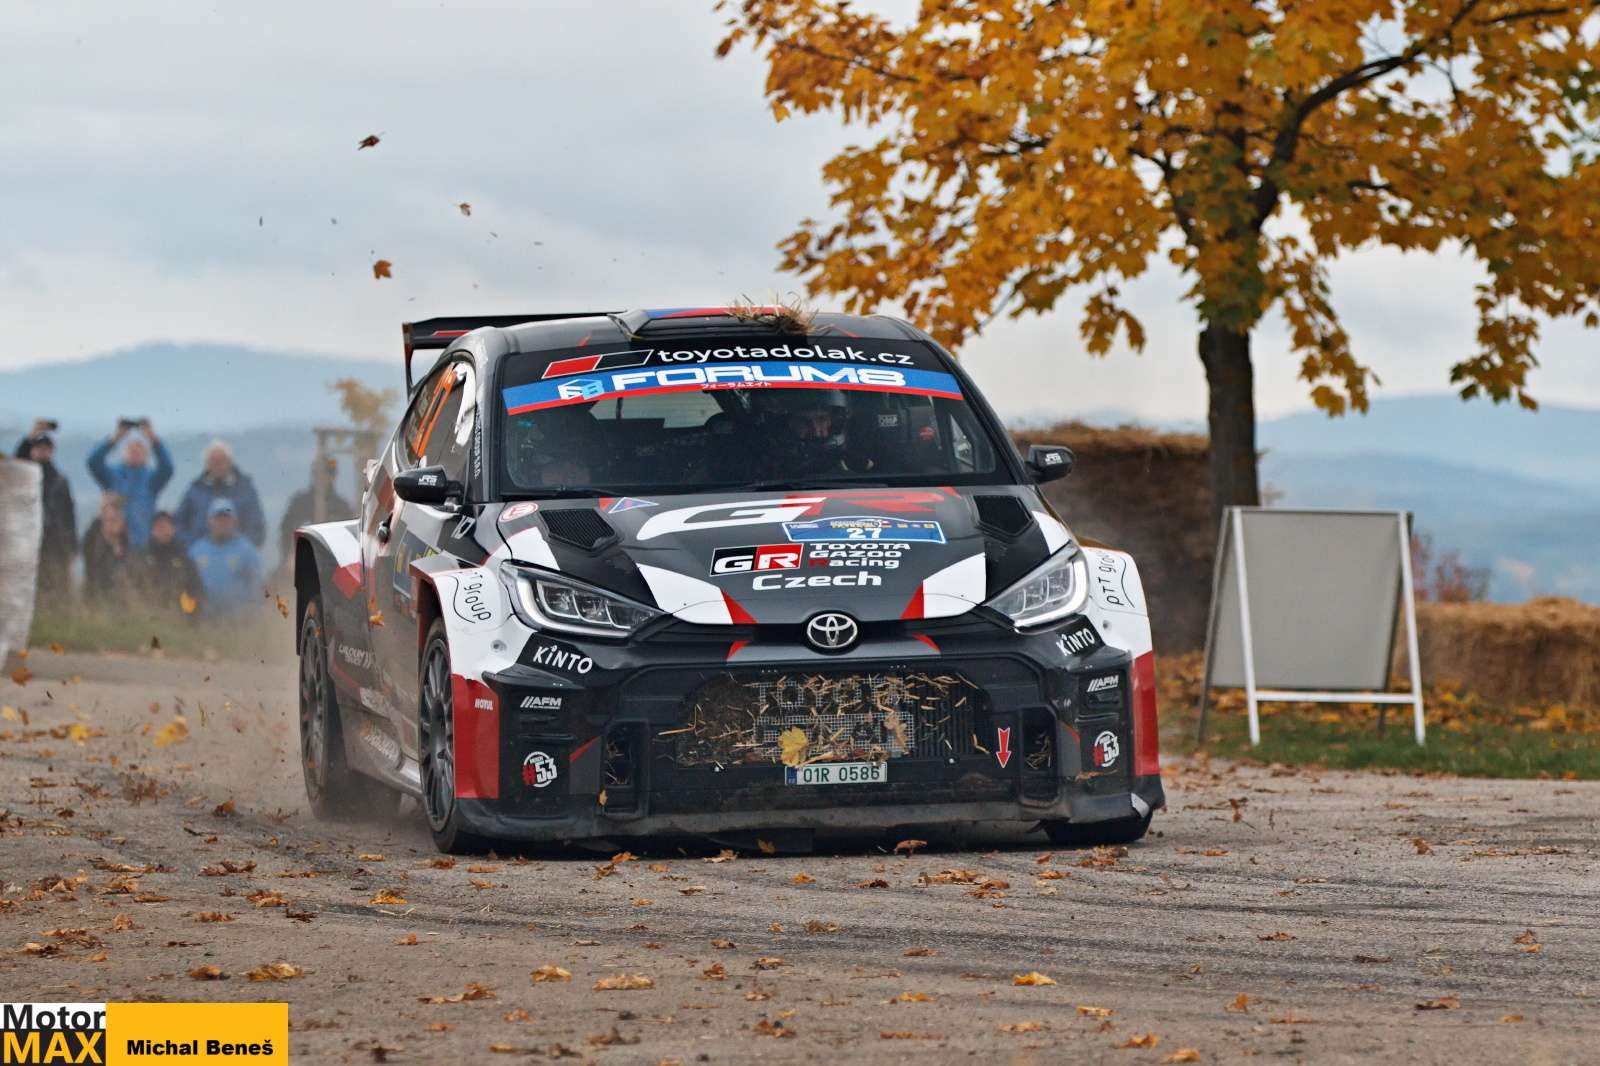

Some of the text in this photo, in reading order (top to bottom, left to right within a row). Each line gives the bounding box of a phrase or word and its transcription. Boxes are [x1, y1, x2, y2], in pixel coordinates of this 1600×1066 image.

[657, 344, 914, 366] toyotadolak.cz
[611, 366, 906, 391] FORUM8
[847, 528, 882, 540] 27
[809, 550, 902, 559] GAZOO
[810, 542, 910, 550] TOYOTA
[713, 552, 799, 573] GR
[808, 557, 900, 569] Racing
[752, 571, 883, 590] Czech
[464, 582, 492, 621] group
[803, 766, 881, 783] 01R 0586
